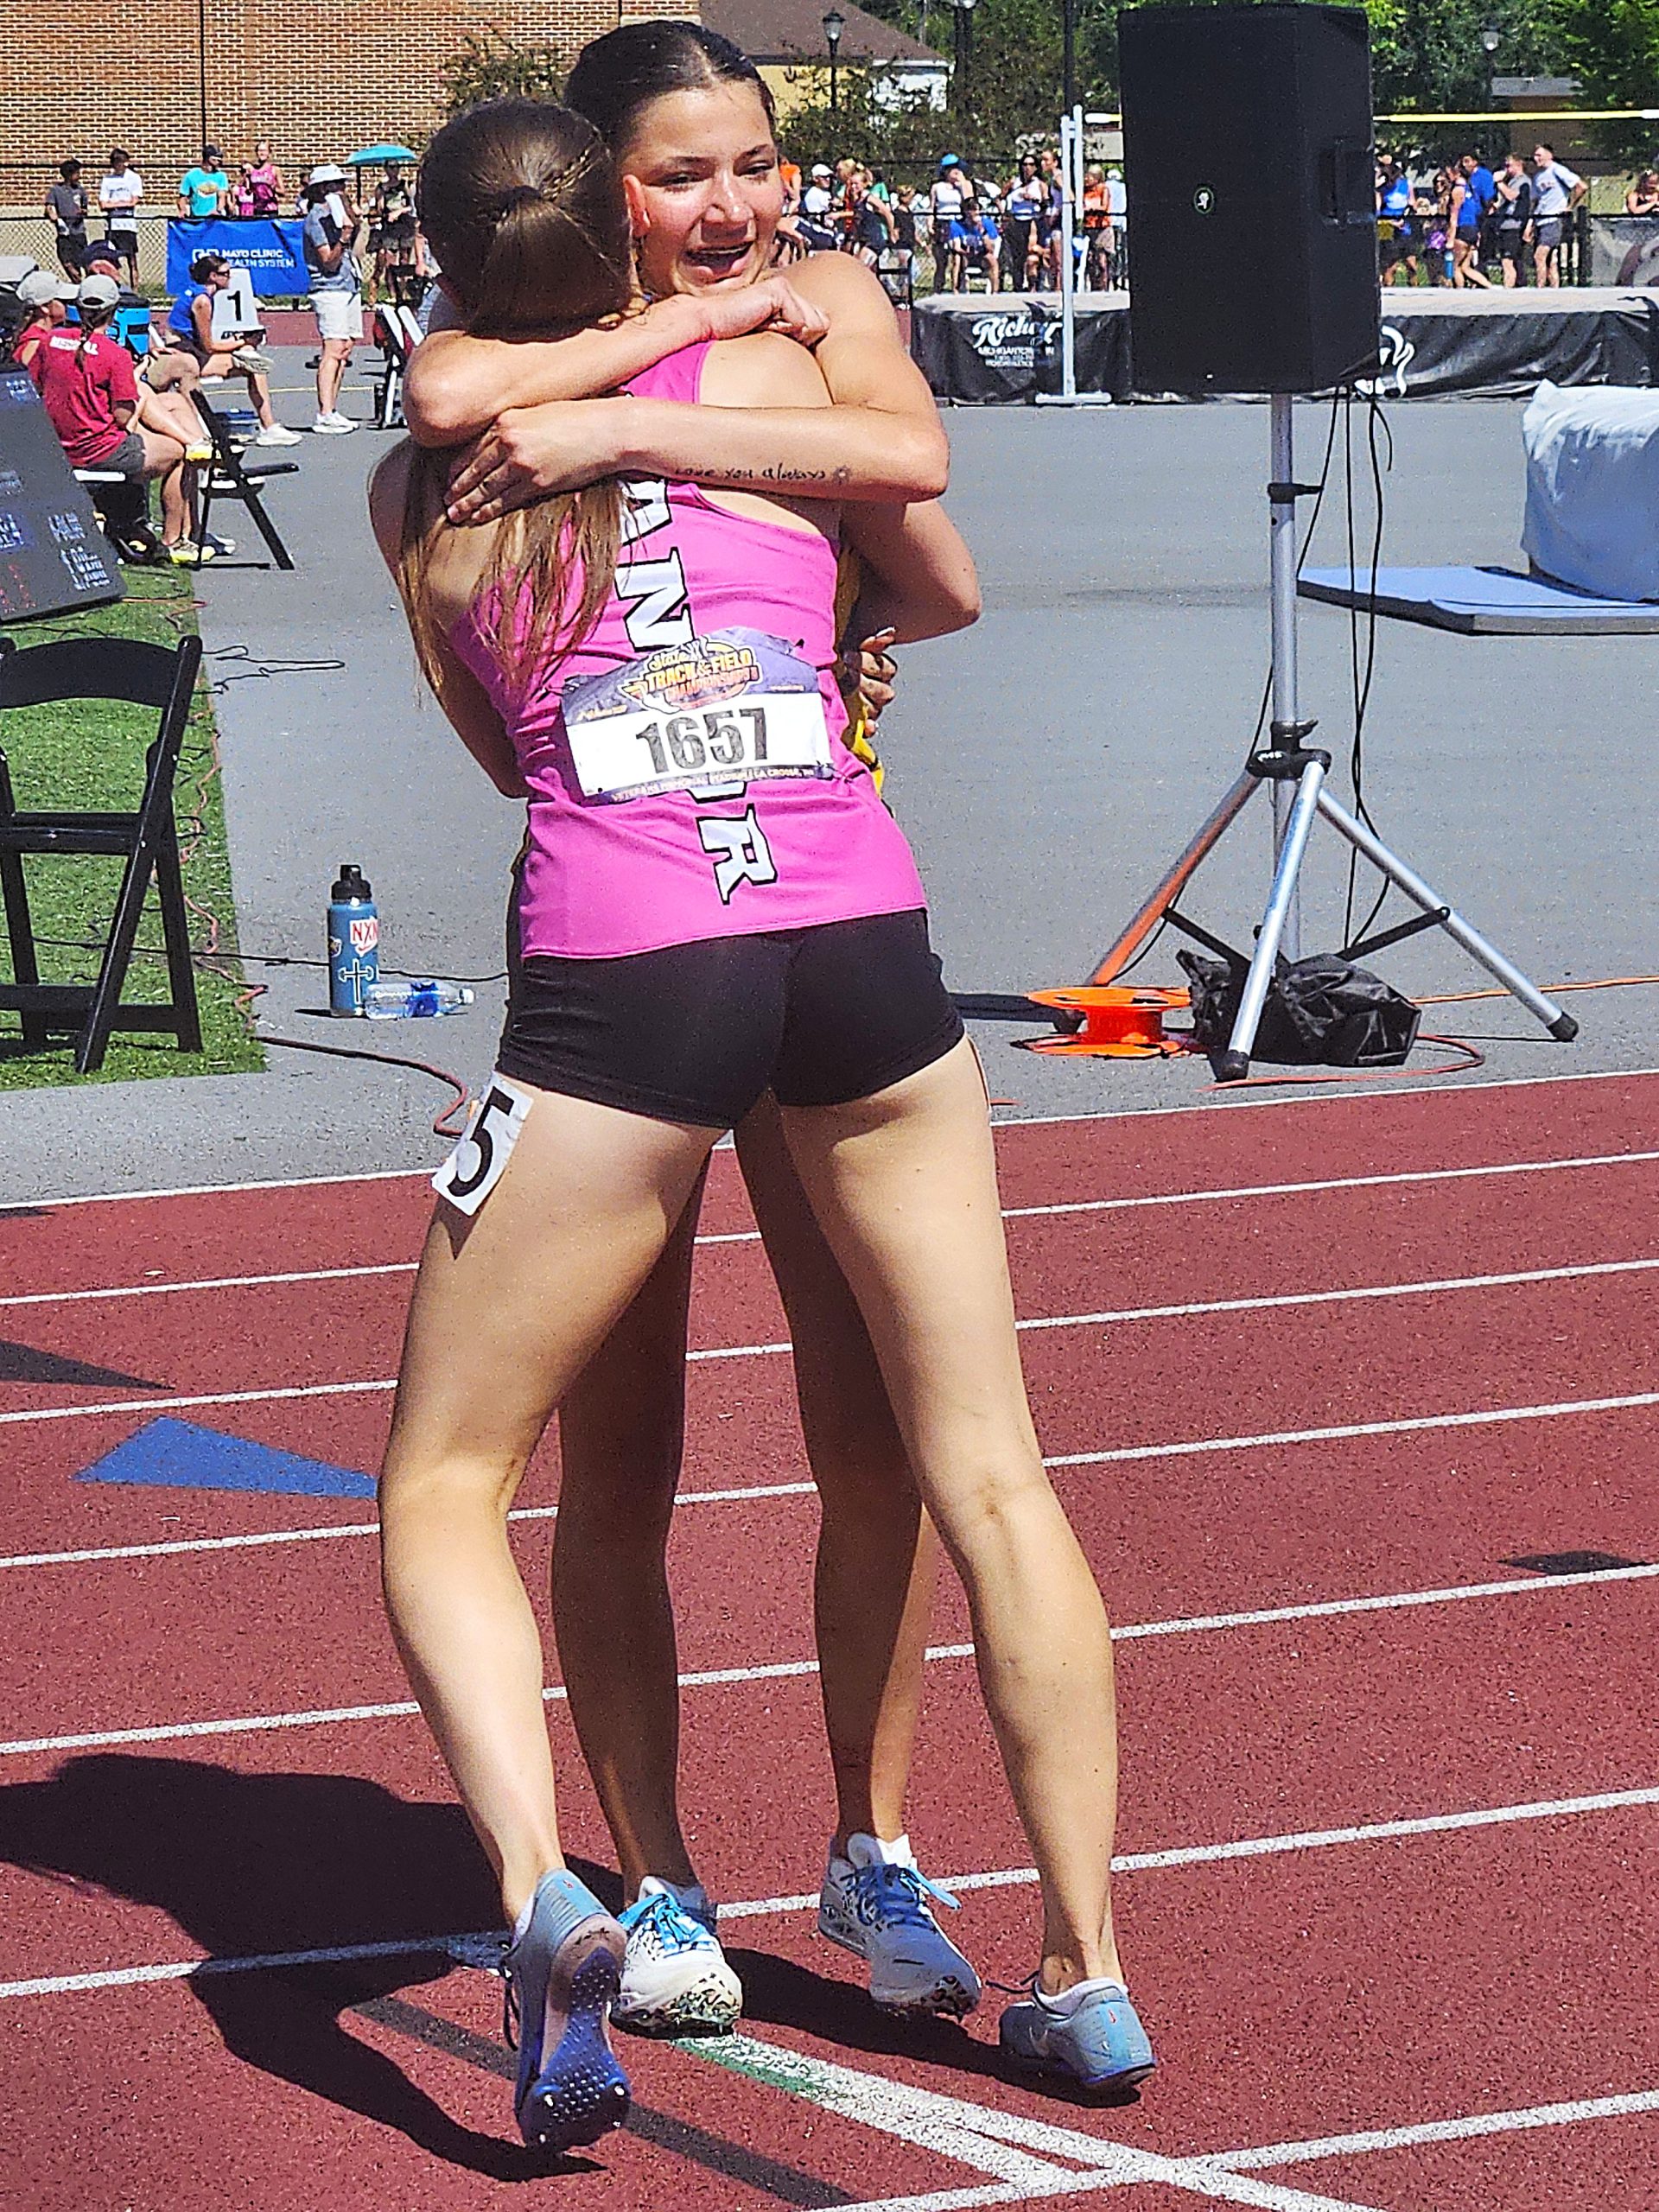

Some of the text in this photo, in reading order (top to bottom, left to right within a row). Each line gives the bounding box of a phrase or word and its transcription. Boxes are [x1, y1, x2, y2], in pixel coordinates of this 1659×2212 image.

[222, 249, 283, 258] MAYO CLINIC
[258, 259, 295, 268] SYSTEM
[227, 290, 242, 321] 1
[646, 648, 753, 692] TRACK & FIELD
[635, 708, 768, 774] 1657
[446, 1085, 515, 1198] 5
